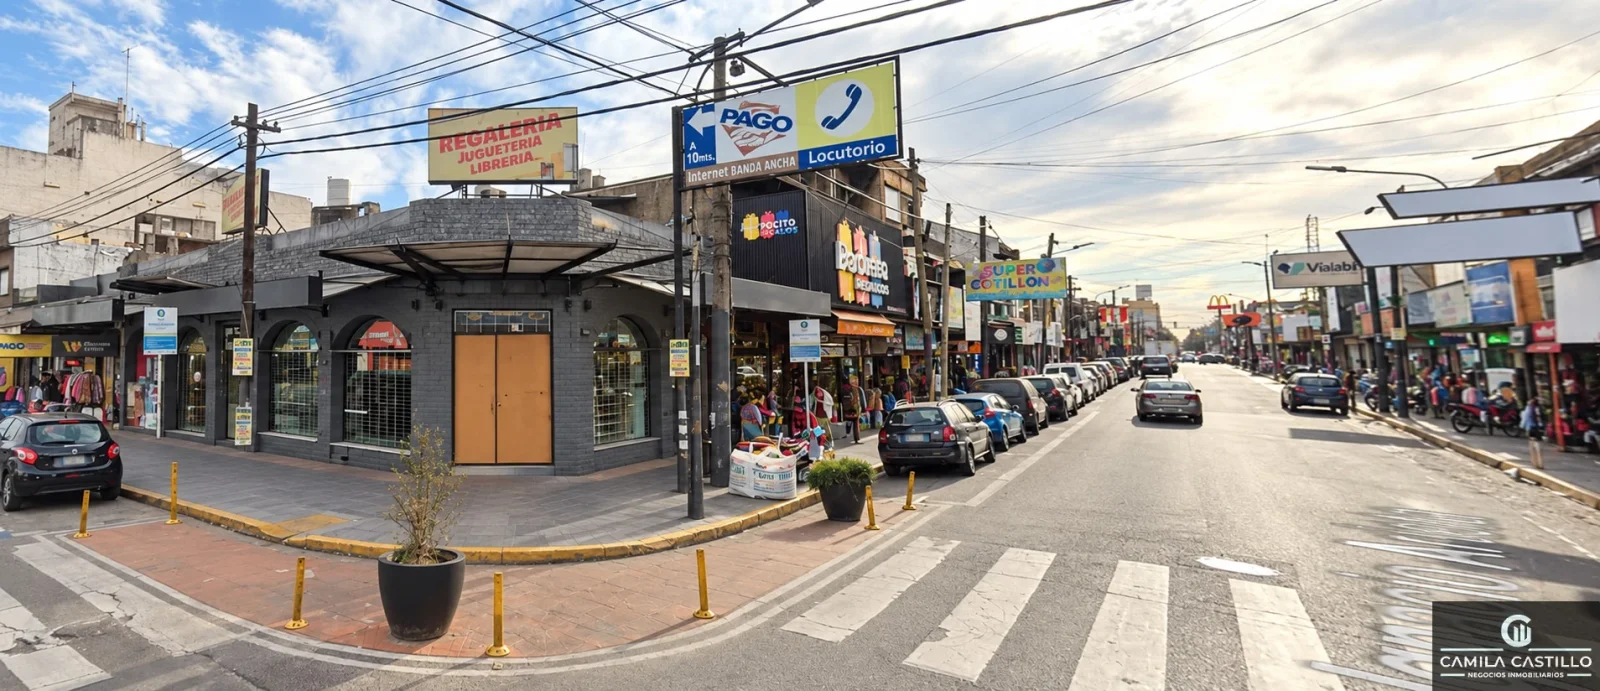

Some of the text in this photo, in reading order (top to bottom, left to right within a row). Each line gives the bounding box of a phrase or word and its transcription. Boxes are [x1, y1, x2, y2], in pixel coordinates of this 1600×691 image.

[439, 112, 563, 153] REGALERIA
[720, 108, 793, 133] PAGO
[457, 135, 542, 164] JUGUETERIA
[686, 152, 715, 164] 10mts.
[689, 142, 697, 151] A
[808, 140, 886, 164] Locutorio
[470, 150, 535, 175] LIBRERIA
[688, 166, 729, 183] Internet
[731, 161, 762, 177] BANDA
[764, 155, 796, 172] ANCHA
[970, 276, 1049, 290] COTILLON
[979, 263, 1036, 279] SUPER
